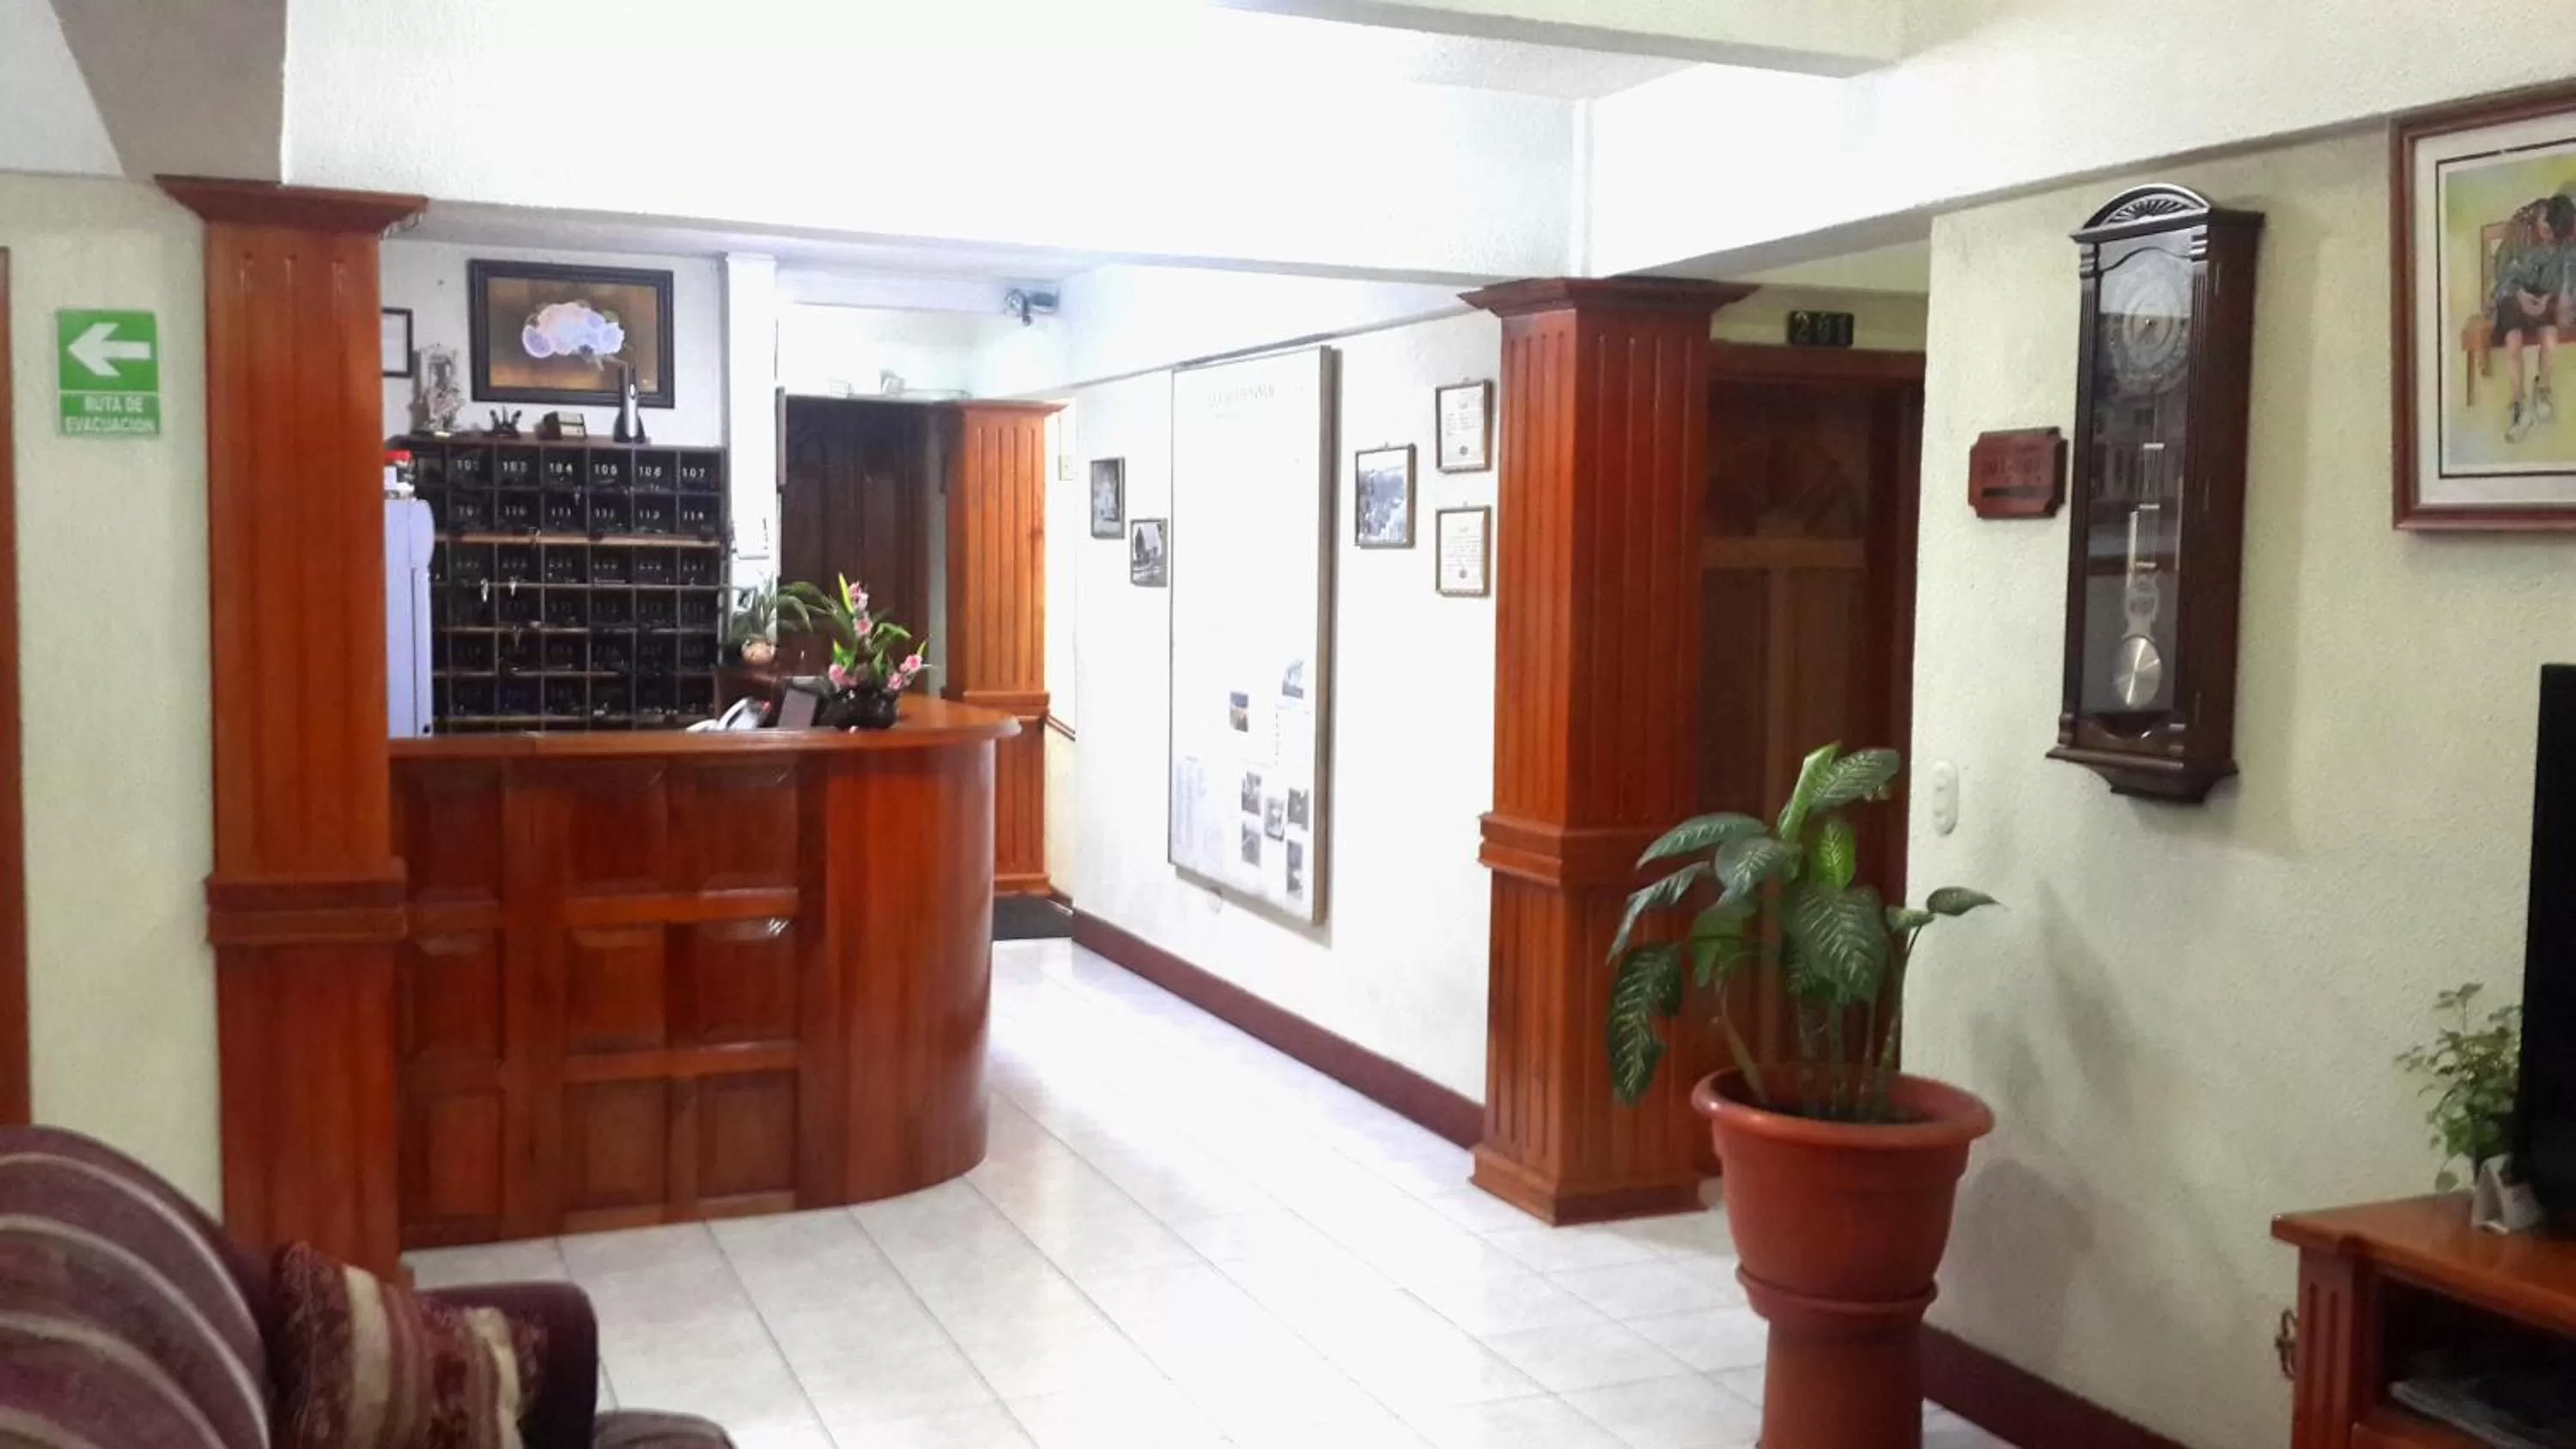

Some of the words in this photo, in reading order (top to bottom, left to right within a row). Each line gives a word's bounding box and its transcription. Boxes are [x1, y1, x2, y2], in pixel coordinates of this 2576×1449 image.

[84, 395, 123, 412] RUTA
[125, 395, 144, 412] DE
[682, 466, 706, 479] 107
